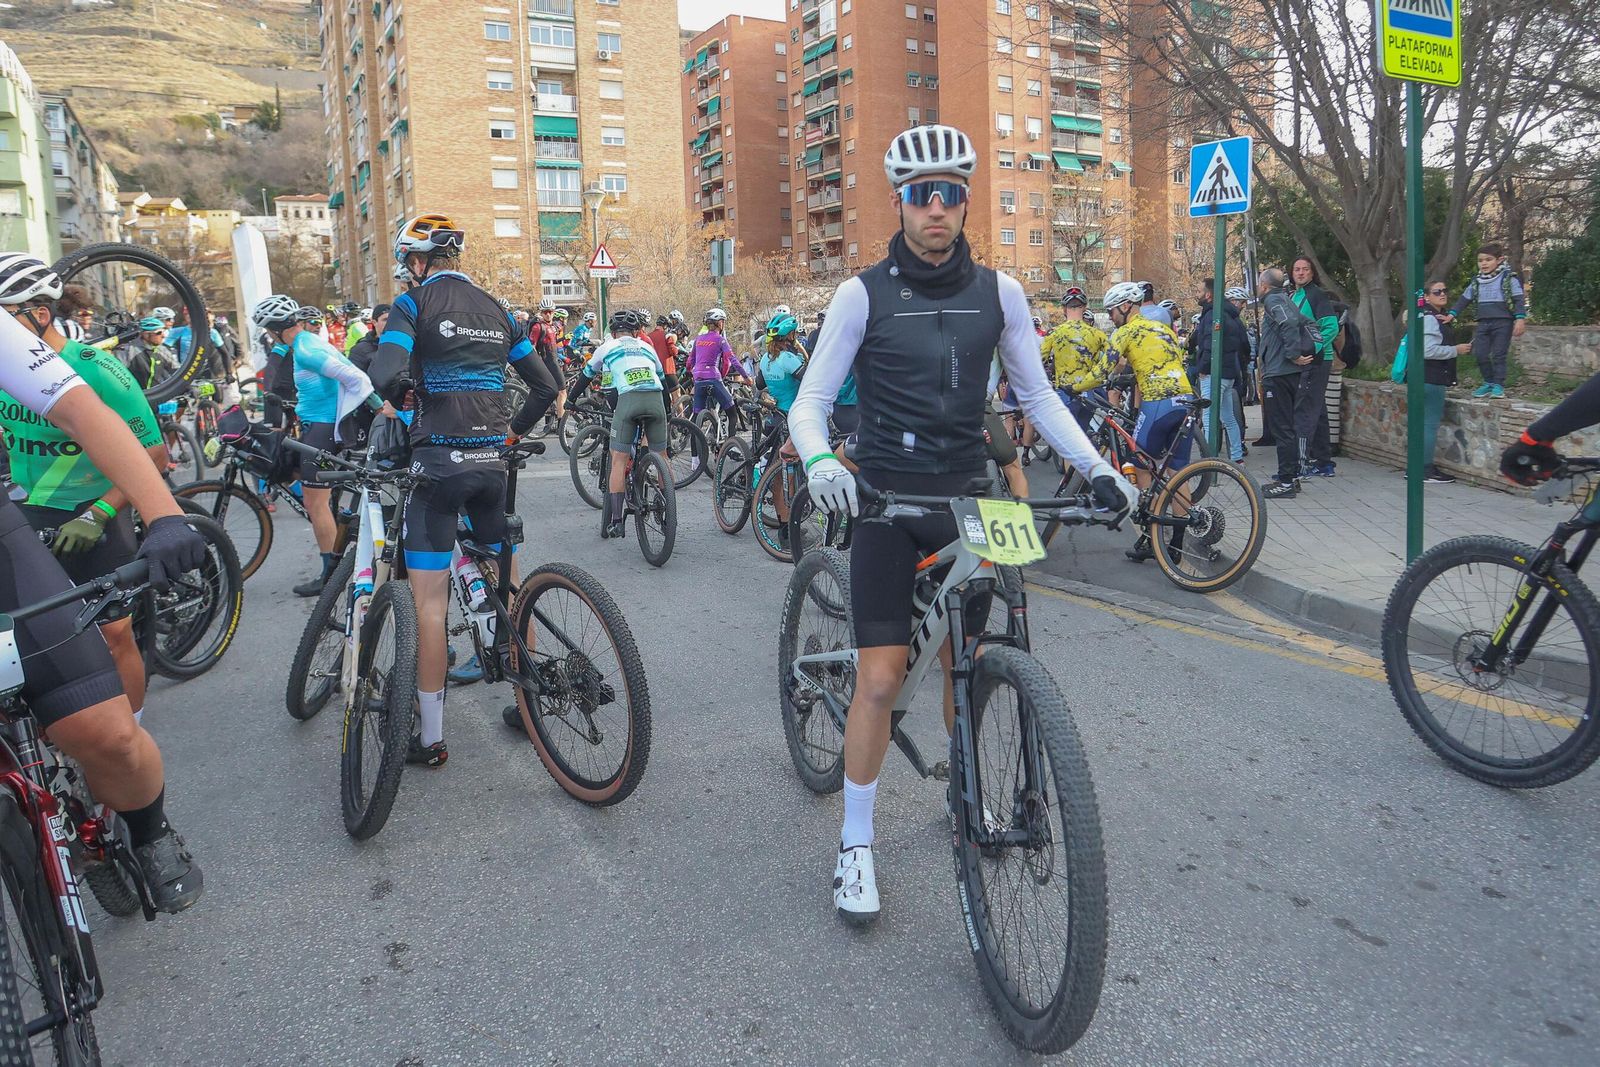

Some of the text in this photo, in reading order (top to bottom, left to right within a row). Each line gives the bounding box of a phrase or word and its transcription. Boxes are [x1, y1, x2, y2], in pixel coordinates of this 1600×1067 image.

[1388, 35, 1454, 59] PLATAFORMA
[1400, 54, 1444, 75] ELEVADA
[456, 326, 504, 340] BROEKHUIS
[183, 345, 205, 381] MAXXIS
[626, 370, 652, 382] 333-2
[990, 519, 1035, 550] 611
[513, 587, 530, 623] RACING
[799, 674, 819, 692] SCOTT
